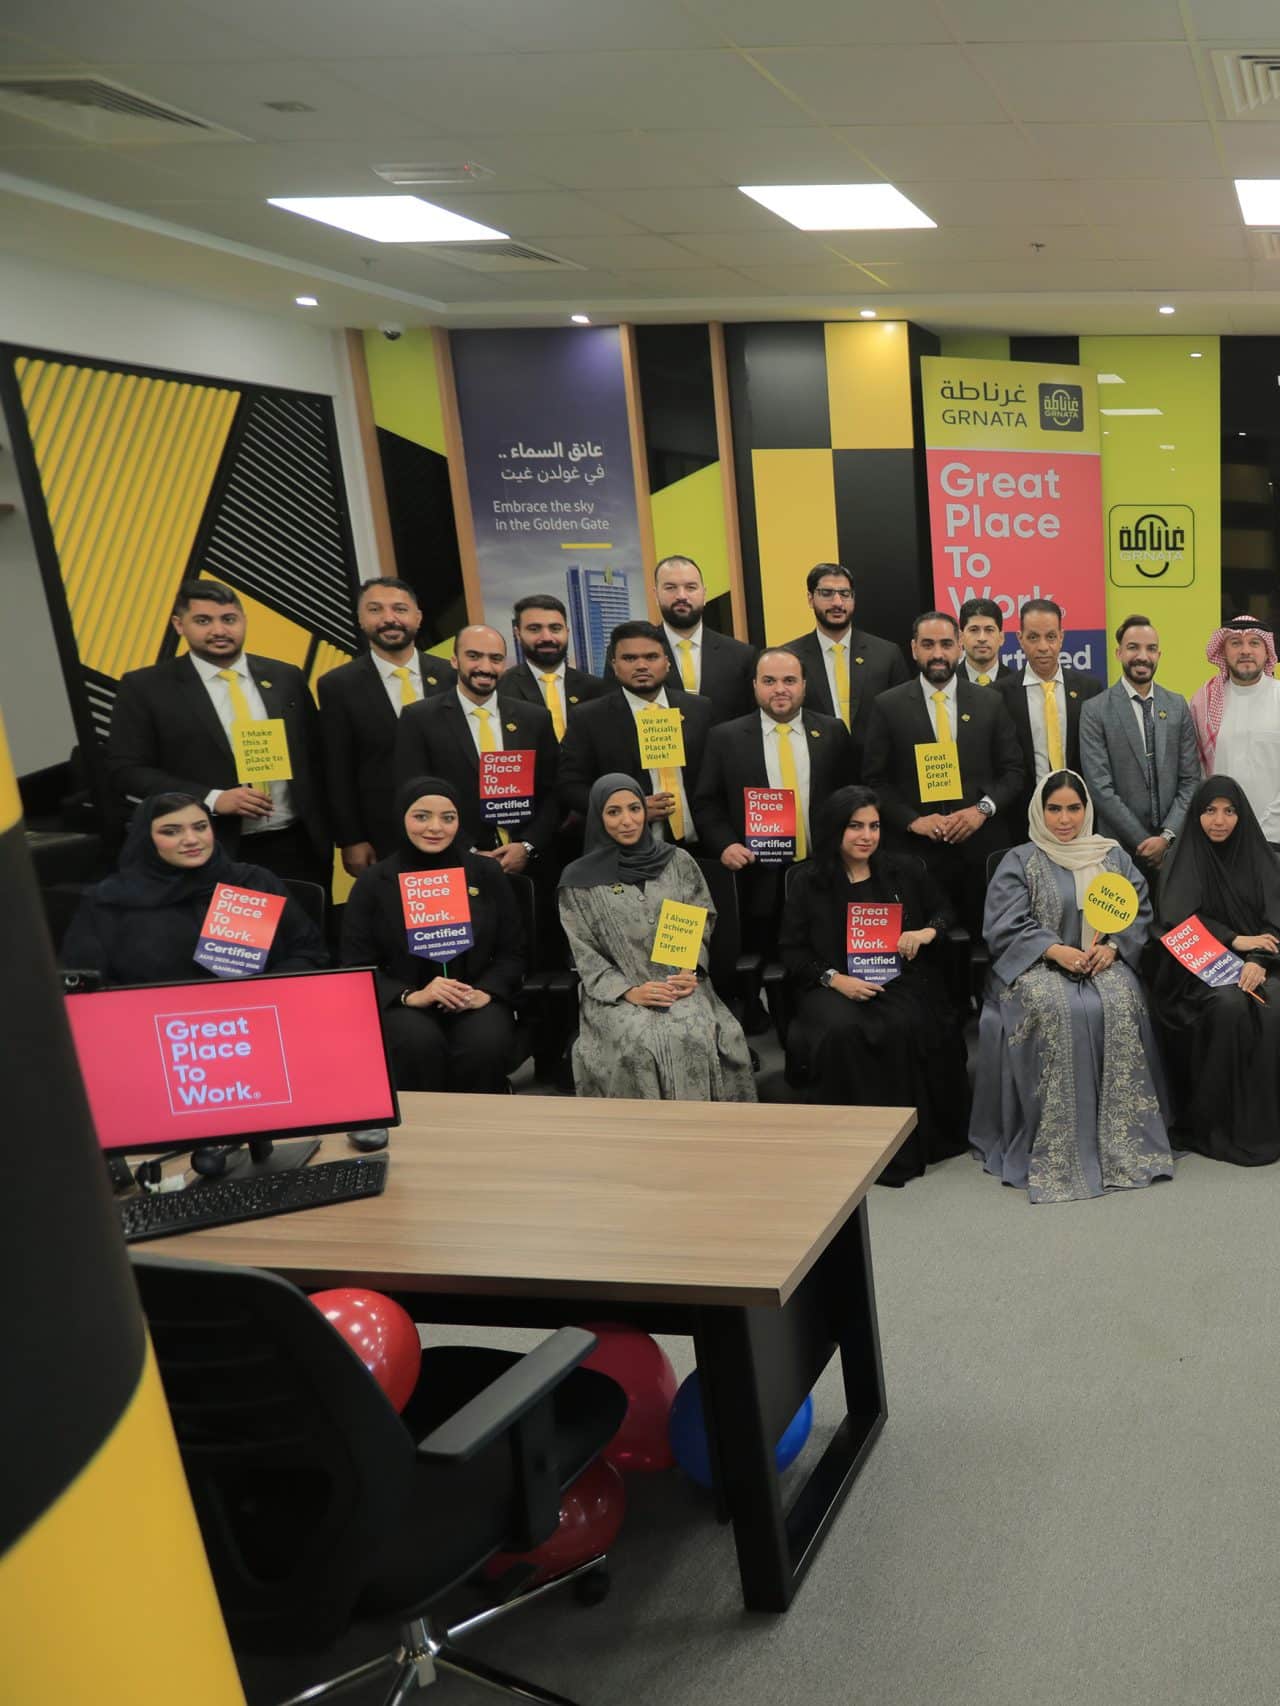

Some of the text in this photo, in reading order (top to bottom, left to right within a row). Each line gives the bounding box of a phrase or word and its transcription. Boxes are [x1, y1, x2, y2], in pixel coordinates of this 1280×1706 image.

[940, 380, 1027, 407] غرناطة
[942, 409, 1028, 428] GRNATA
[511, 441, 564, 459] السماء
[568, 441, 603, 462] عانق
[501, 463, 605, 486] في غولدن غيت
[940, 462, 1061, 499] Great
[493, 500, 595, 514] Embrace the sky
[496, 517, 610, 531] in the Golden Gate
[946, 504, 1061, 538] Place
[944, 546, 992, 578] To
[1119, 550, 1185, 561] GRNATA
[245, 747, 269, 757] great
[483, 754, 522, 763] Great
[246, 756, 271, 765] place
[484, 764, 521, 774] Place
[927, 771, 948, 779] Great
[483, 775, 498, 784] To
[748, 791, 783, 800] Great
[486, 799, 529, 810] Certified
[749, 801, 783, 811] Place
[749, 811, 763, 821] To
[750, 839, 792, 848] Certified
[405, 874, 449, 887] Great
[220, 888, 268, 907] Great
[407, 887, 450, 900] Place
[1100, 885, 1126, 905] We're
[216, 900, 263, 919] Place
[407, 901, 425, 912] To
[851, 906, 888, 916] Great
[1088, 892, 1130, 921] Certified!
[213, 911, 230, 925] To
[852, 916, 888, 926] Place
[414, 926, 466, 941] Certified
[664, 923, 694, 935] achieve
[851, 927, 865, 937] To
[1166, 925, 1193, 946] Great
[662, 933, 673, 941] my
[204, 942, 261, 961] Certified
[1173, 934, 1200, 955] Place
[853, 956, 896, 965] Certified
[1179, 952, 1194, 962] To
[1202, 954, 1233, 978] Certified
[166, 1017, 249, 1040] Great
[171, 1042, 251, 1062] Place
[173, 1065, 206, 1083] To
